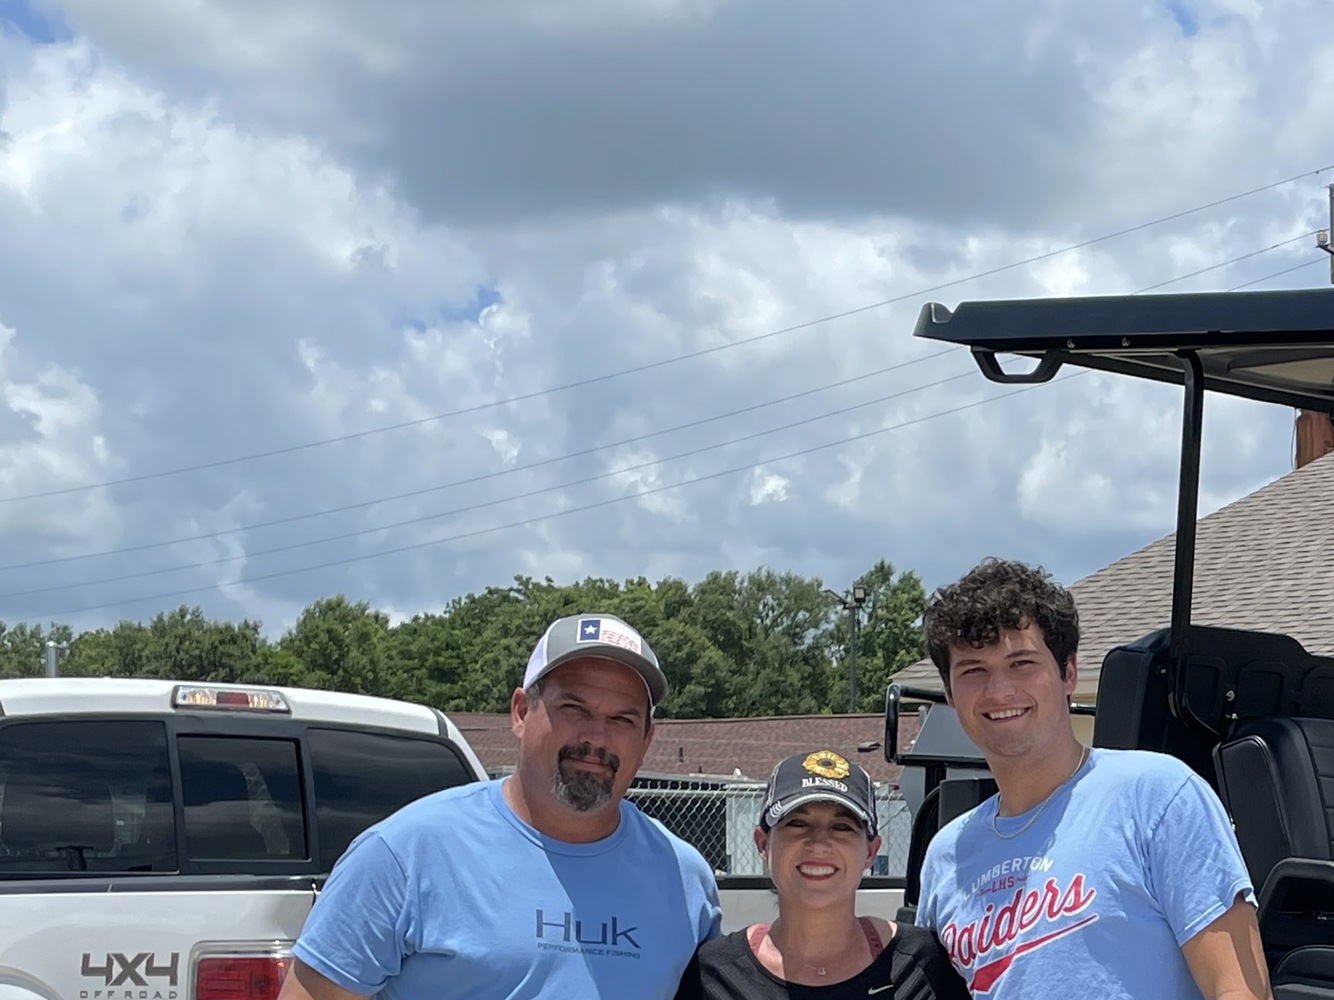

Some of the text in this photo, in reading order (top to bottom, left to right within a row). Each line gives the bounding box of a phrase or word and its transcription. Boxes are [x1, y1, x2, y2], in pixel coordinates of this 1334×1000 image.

[802, 777, 848, 792] BLESSED
[992, 876, 1015, 893] LHS
[536, 909, 641, 949] Huk
[537, 942, 641, 959] PERFORMANCE FISHING
[80, 990, 178, 1000] OFF ROAD
